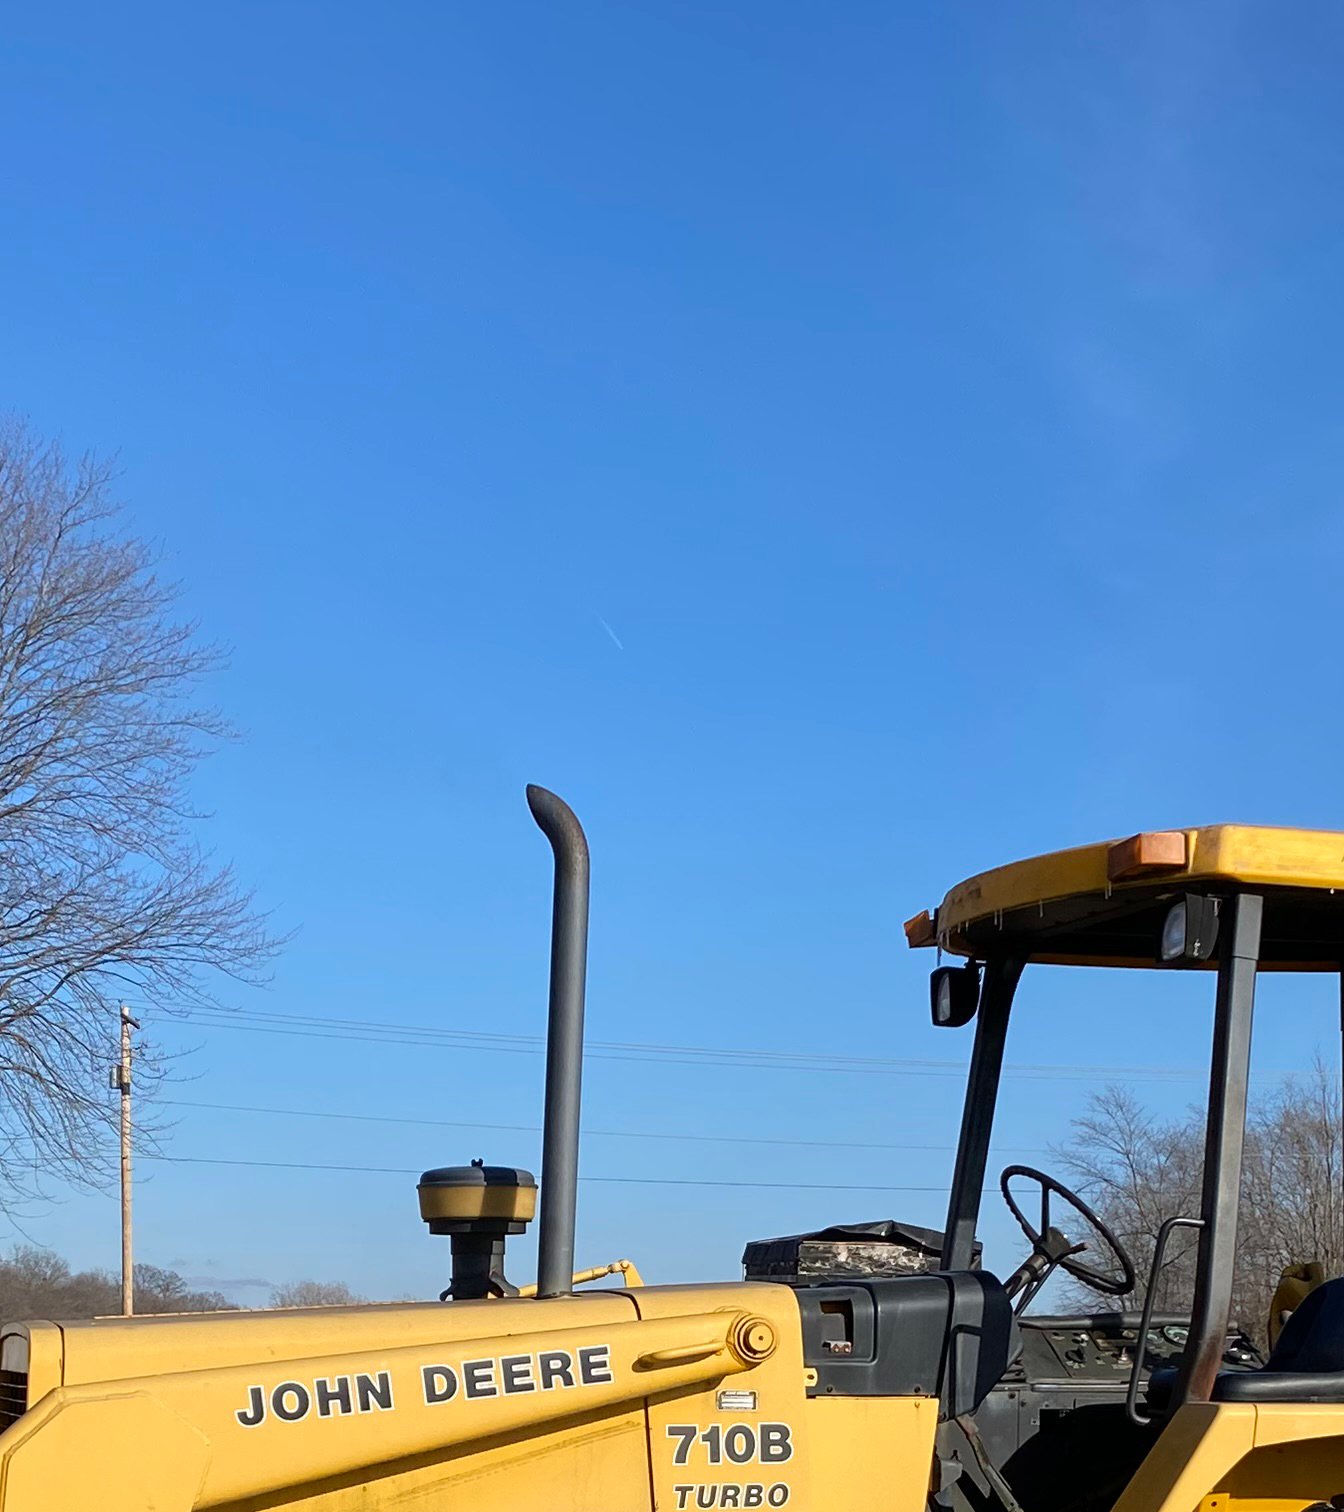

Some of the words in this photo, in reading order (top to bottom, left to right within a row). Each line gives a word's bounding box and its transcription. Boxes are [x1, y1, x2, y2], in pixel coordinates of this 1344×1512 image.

[236, 1371, 393, 1427] JOHN
[421, 1345, 614, 1405] DEERE
[666, 1422, 793, 1465] 710B
[673, 1482, 790, 1509] TURBO
